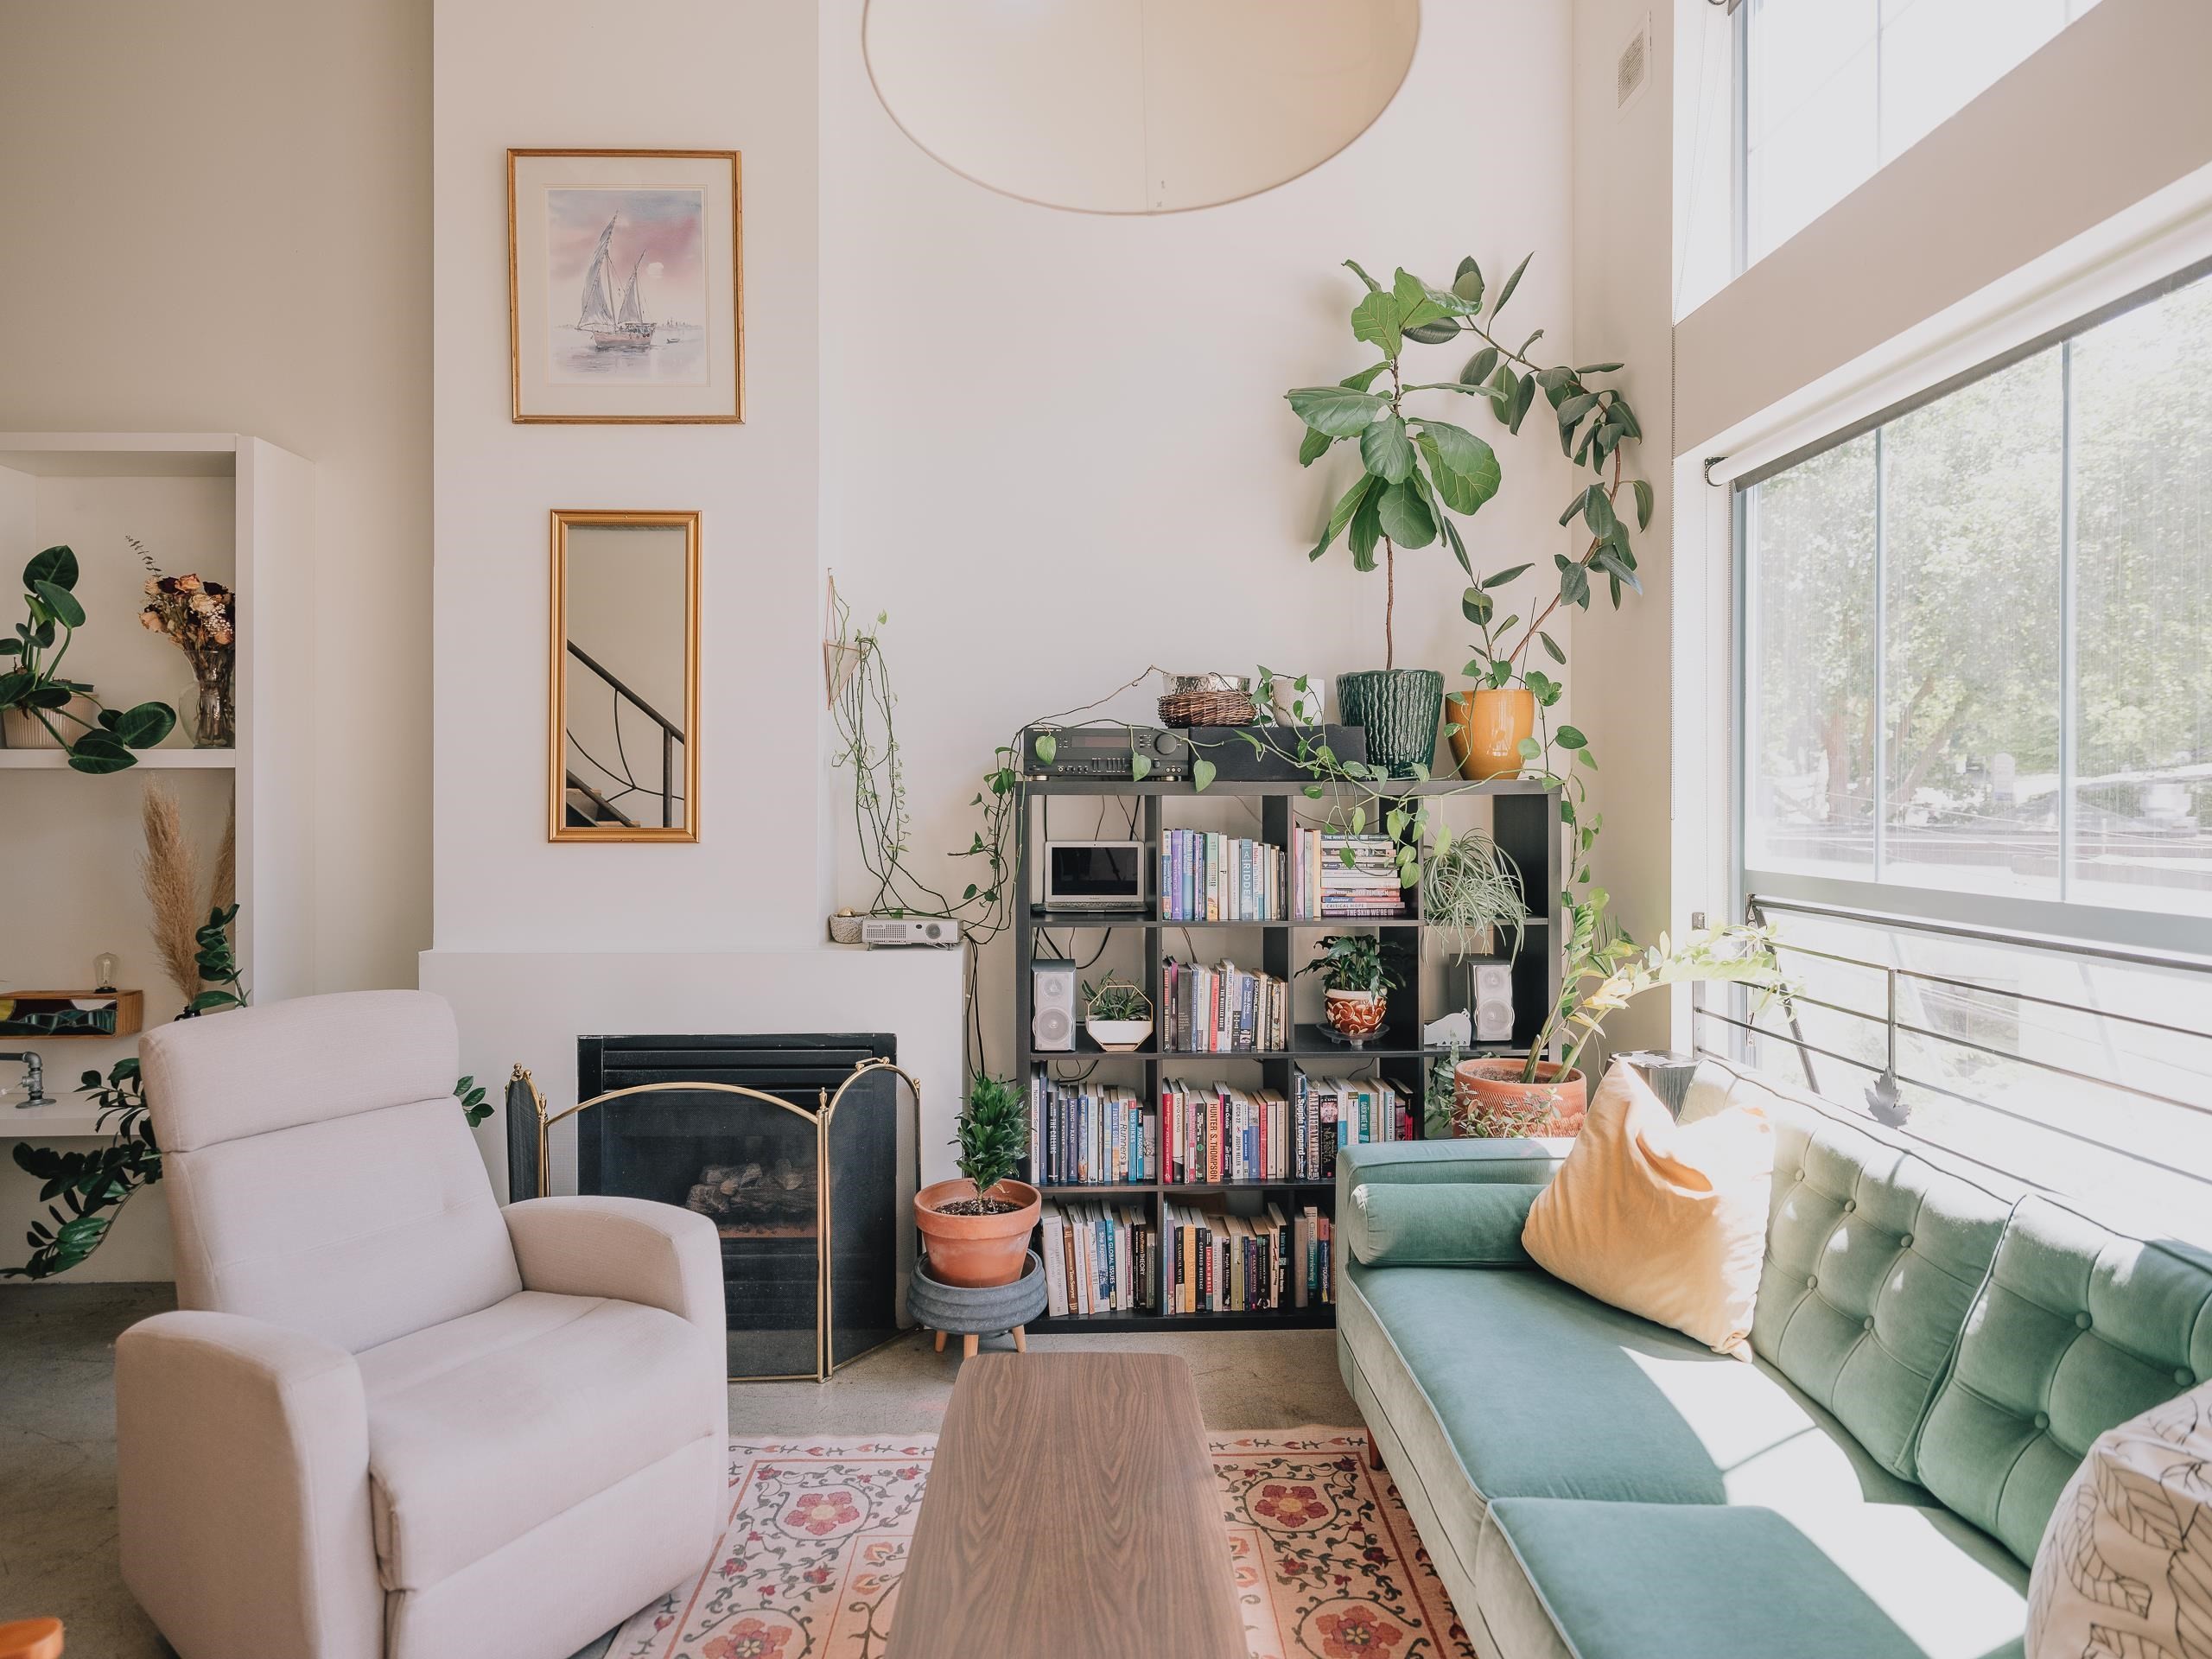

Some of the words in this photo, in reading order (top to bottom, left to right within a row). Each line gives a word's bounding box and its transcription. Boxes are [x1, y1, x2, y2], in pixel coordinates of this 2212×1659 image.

[1296, 1098, 1305, 1124] Supple
[1296, 1125, 1305, 1155] Leopard
[1323, 1128, 1332, 1163] NARNIA
